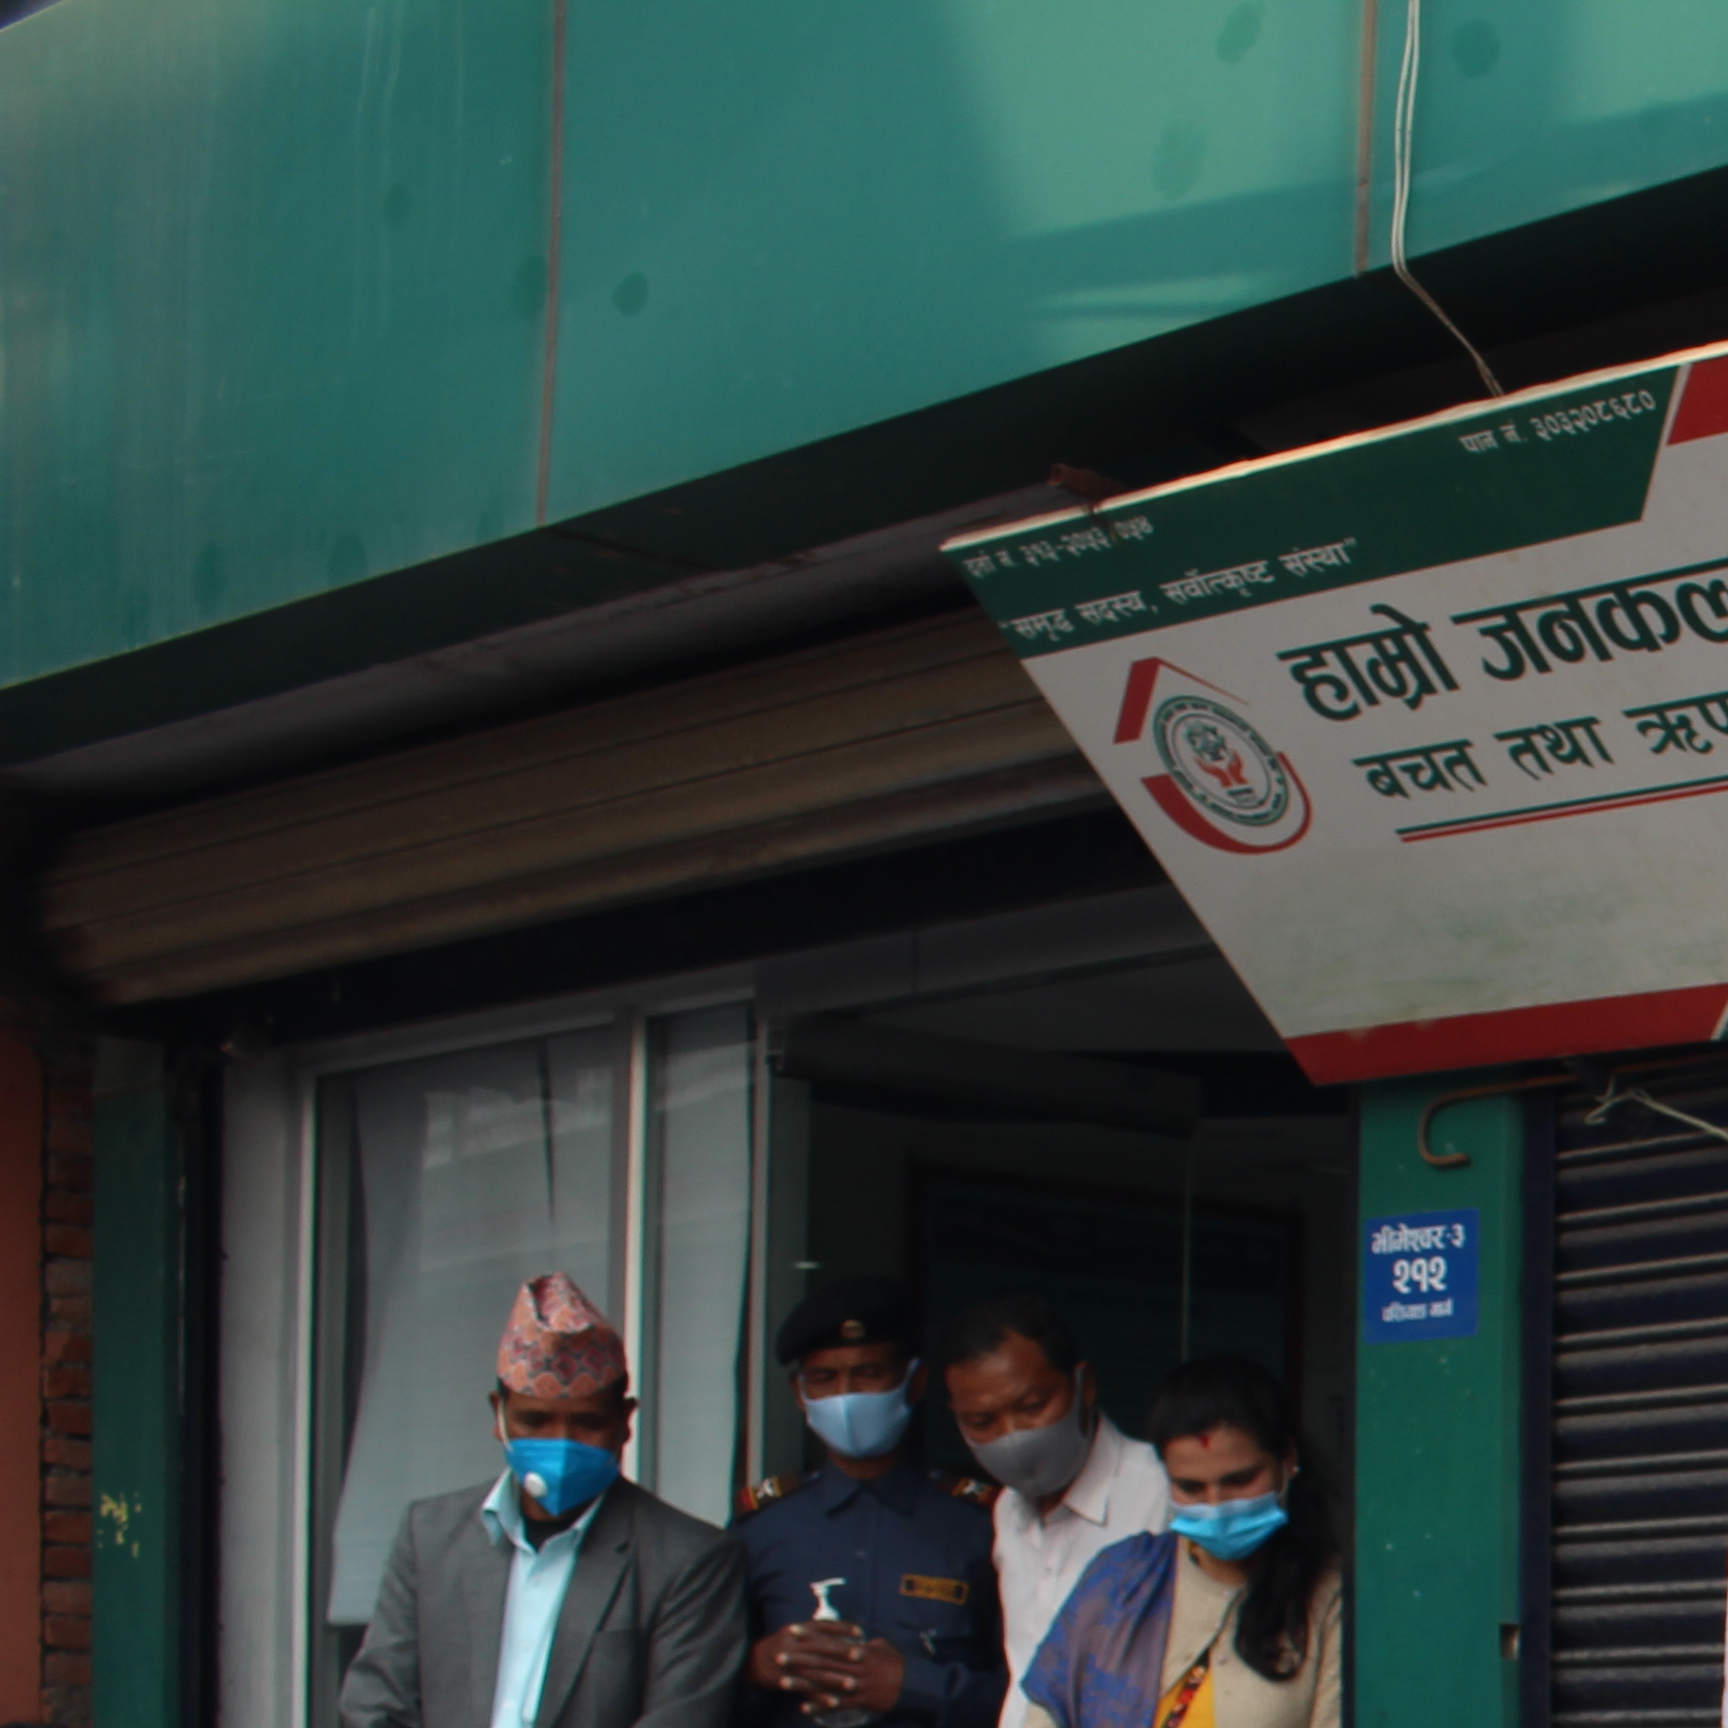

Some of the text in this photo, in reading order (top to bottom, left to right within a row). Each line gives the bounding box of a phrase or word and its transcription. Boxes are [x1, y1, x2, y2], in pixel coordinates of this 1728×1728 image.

[1276, 604, 1459, 721] हाम्रो
[1352, 740, 1488, 800] बचत
[1494, 717, 1614, 780] तथा
